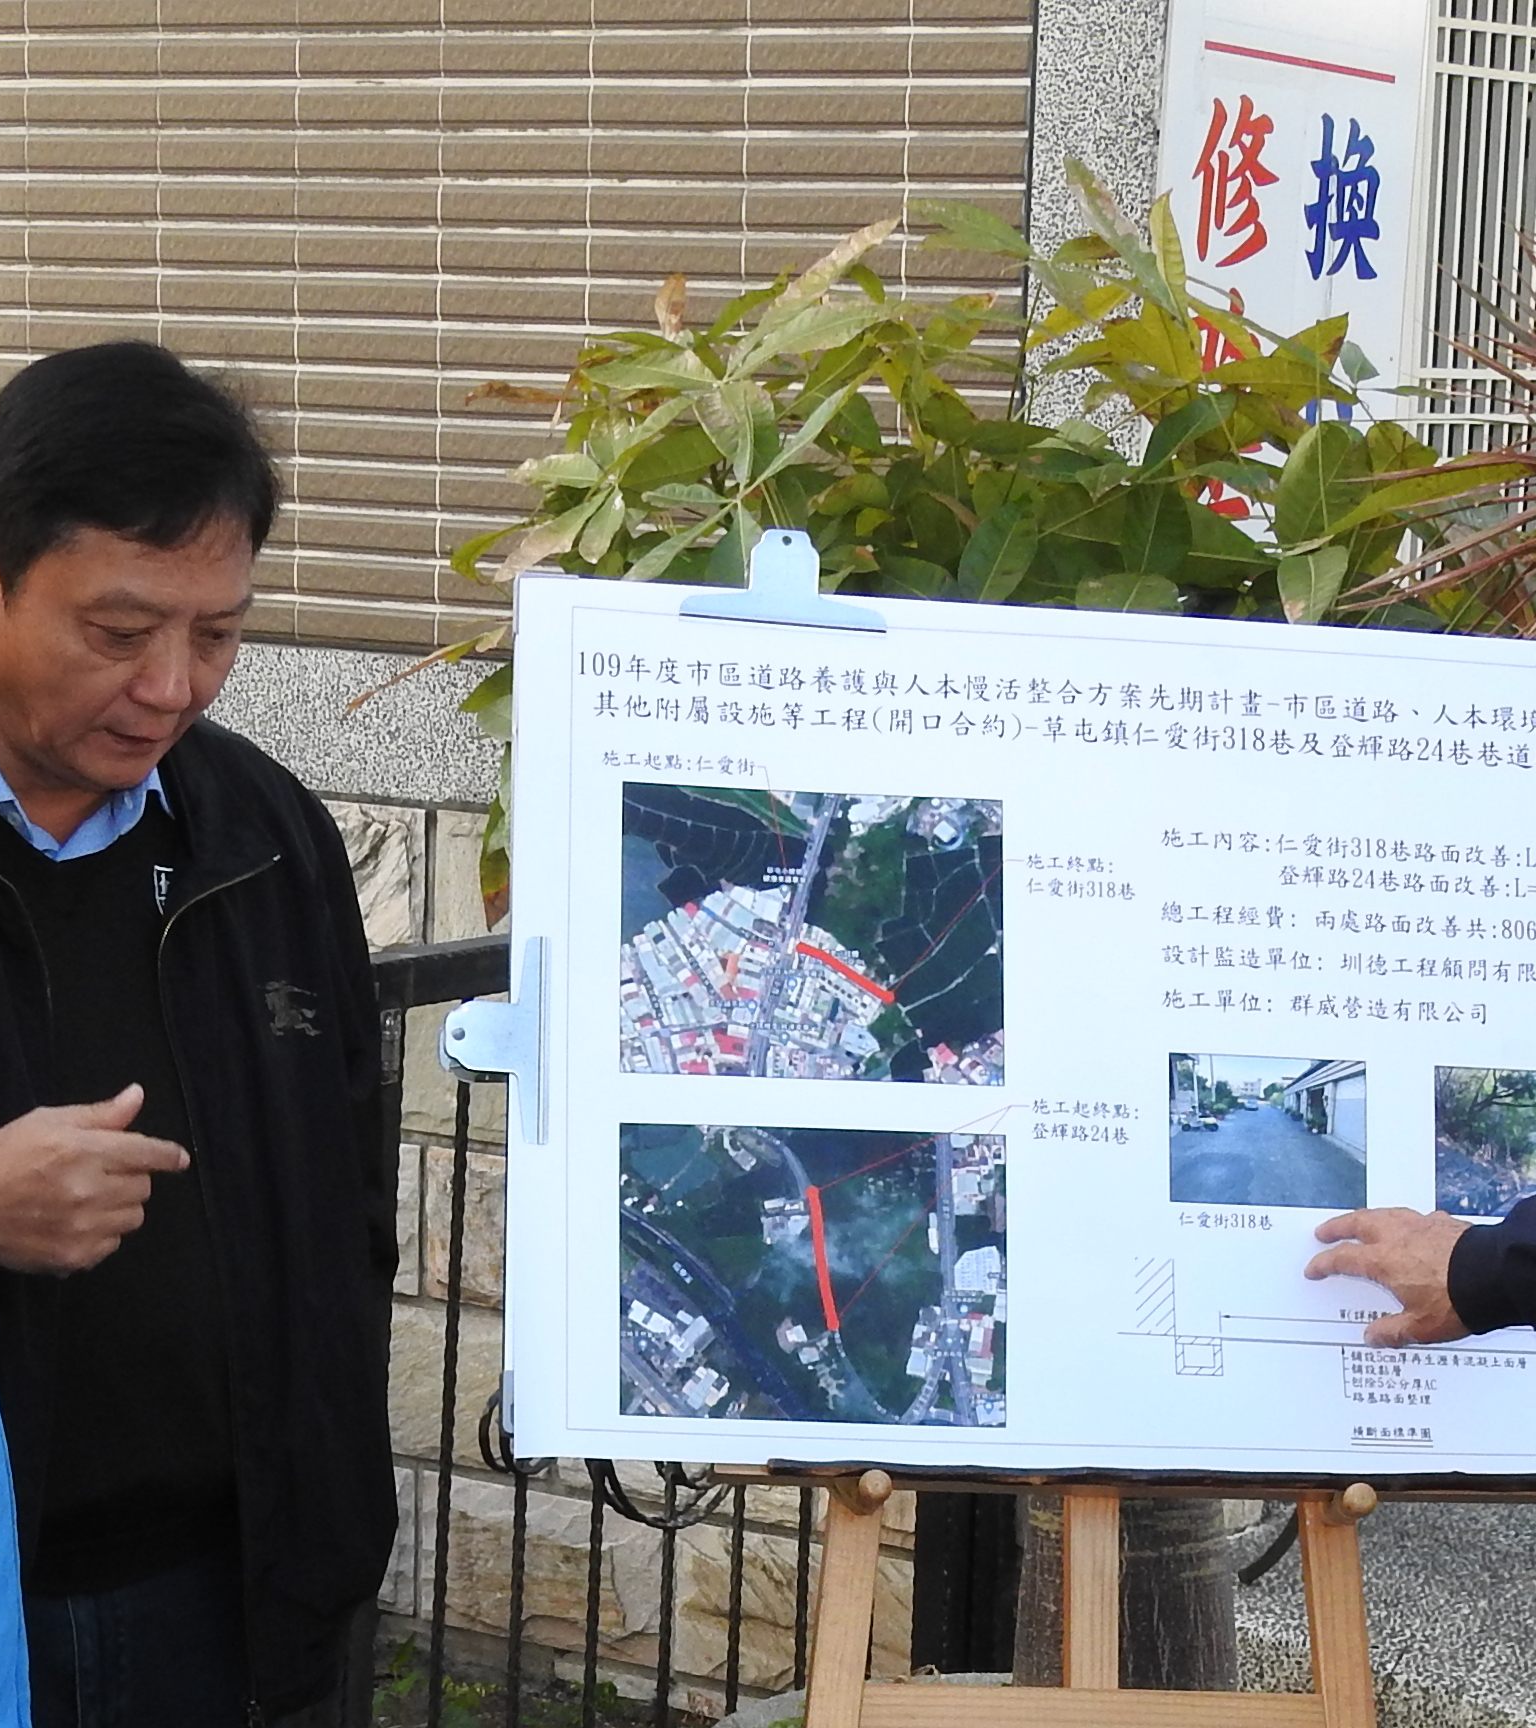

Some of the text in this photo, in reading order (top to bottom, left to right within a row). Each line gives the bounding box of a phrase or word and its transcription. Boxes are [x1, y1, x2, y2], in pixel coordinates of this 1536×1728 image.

[1026, 877, 1136, 901] 仁愛街318巷
[1179, 1211, 1273, 1231] 仁愛街318巷
